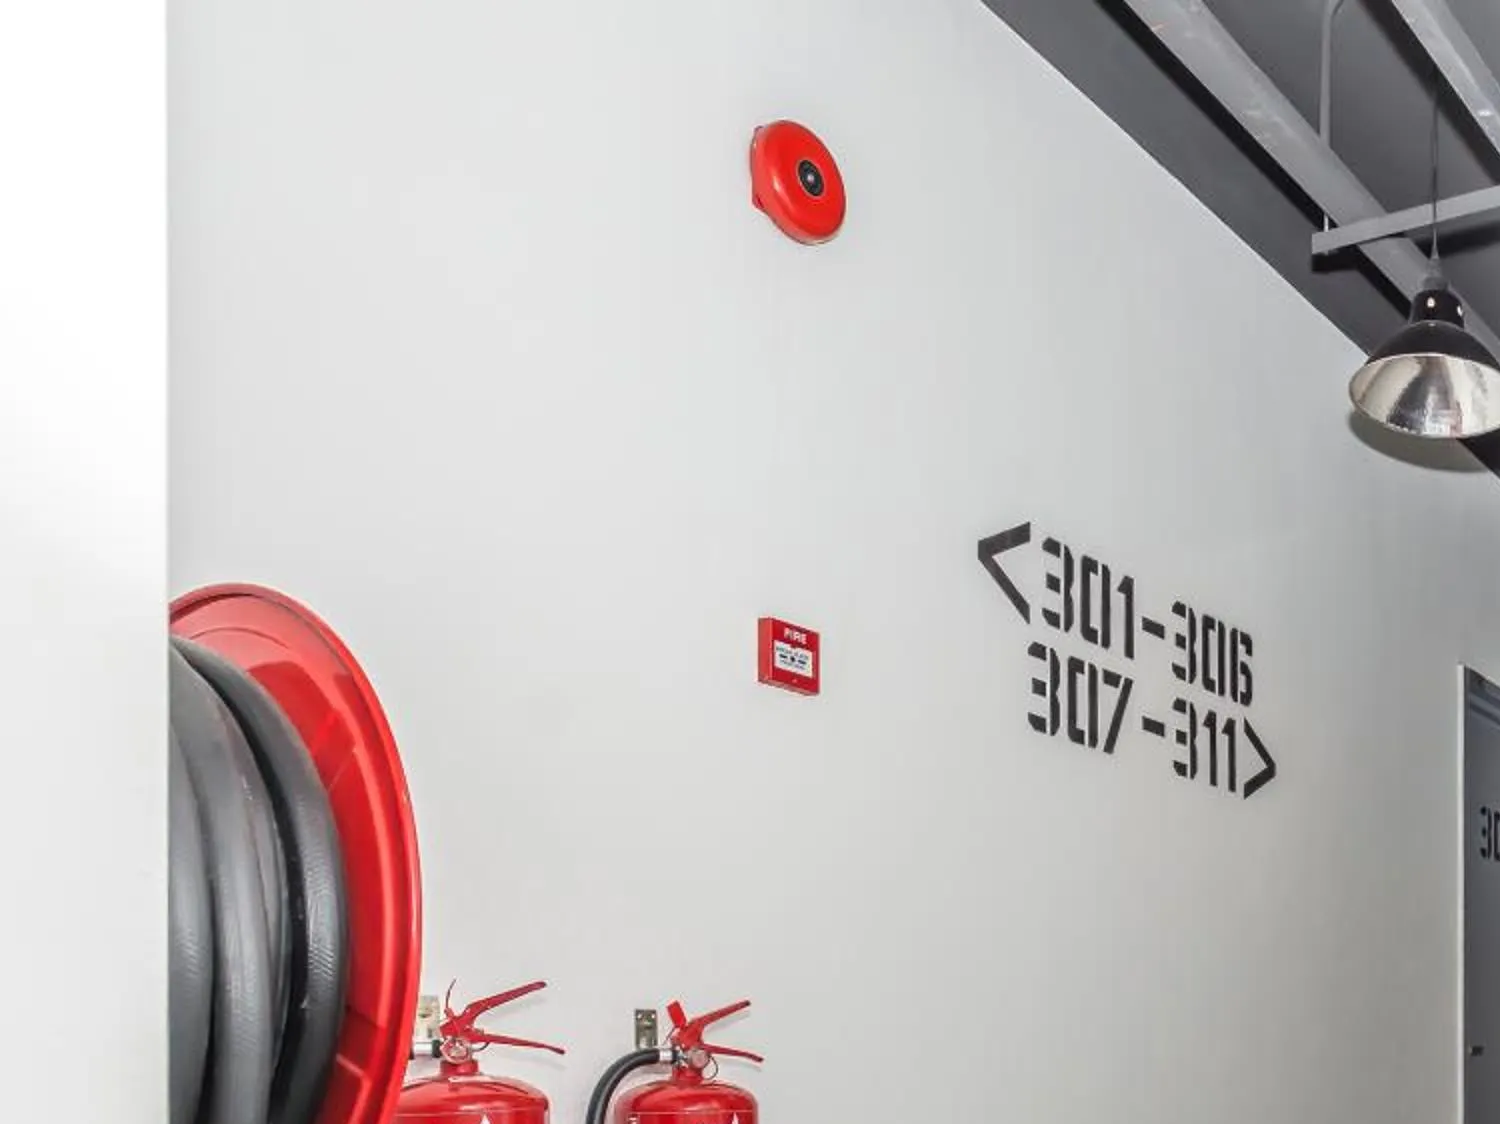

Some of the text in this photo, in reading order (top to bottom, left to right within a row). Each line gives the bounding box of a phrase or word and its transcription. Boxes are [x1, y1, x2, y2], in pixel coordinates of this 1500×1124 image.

[783, 628, 807, 645] FIRE
[1041, 536, 1254, 707] 301-306
[1027, 641, 1238, 793] 307-311
